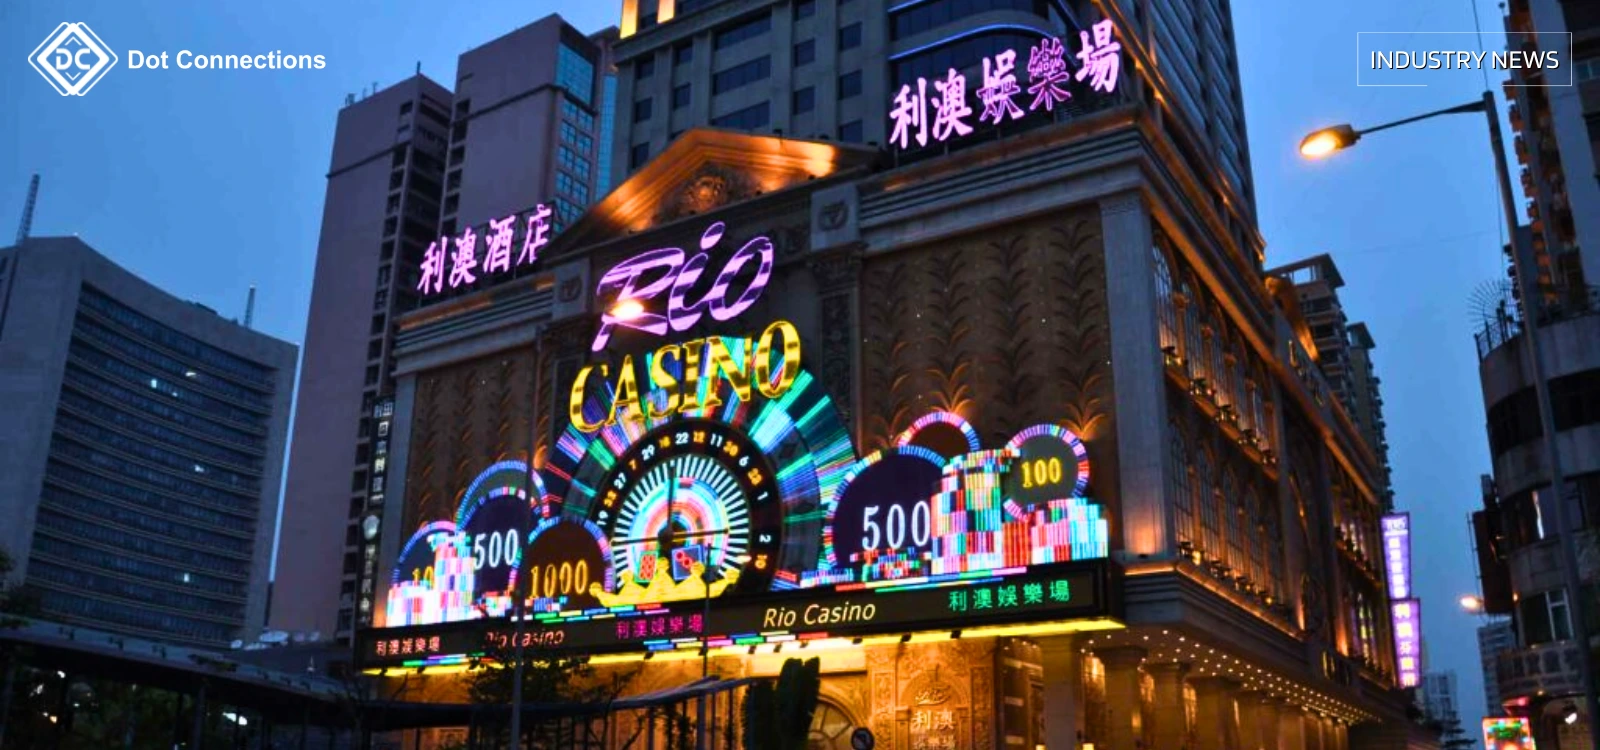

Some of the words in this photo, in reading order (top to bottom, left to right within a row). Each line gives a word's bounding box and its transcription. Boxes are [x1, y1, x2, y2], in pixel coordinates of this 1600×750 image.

[417, 204, 552, 295] 利澳酒店
[569, 320, 801, 433] CASINO
[613, 472, 627, 489] 27
[628, 459, 638, 471] 7
[641, 444, 655, 461] 29
[675, 431, 689, 445] 22
[710, 433, 723, 448] 11
[739, 456, 749, 468] 6
[759, 534, 772, 543] 2
[1021, 457, 1062, 487] 100
[862, 500, 931, 550] 500
[474, 529, 519, 570] 500
[530, 560, 588, 598] 1000
[949, 580, 1070, 612] 利澳娛樂場
[763, 607, 796, 628] Rio
[804, 601, 876, 625] Casino
